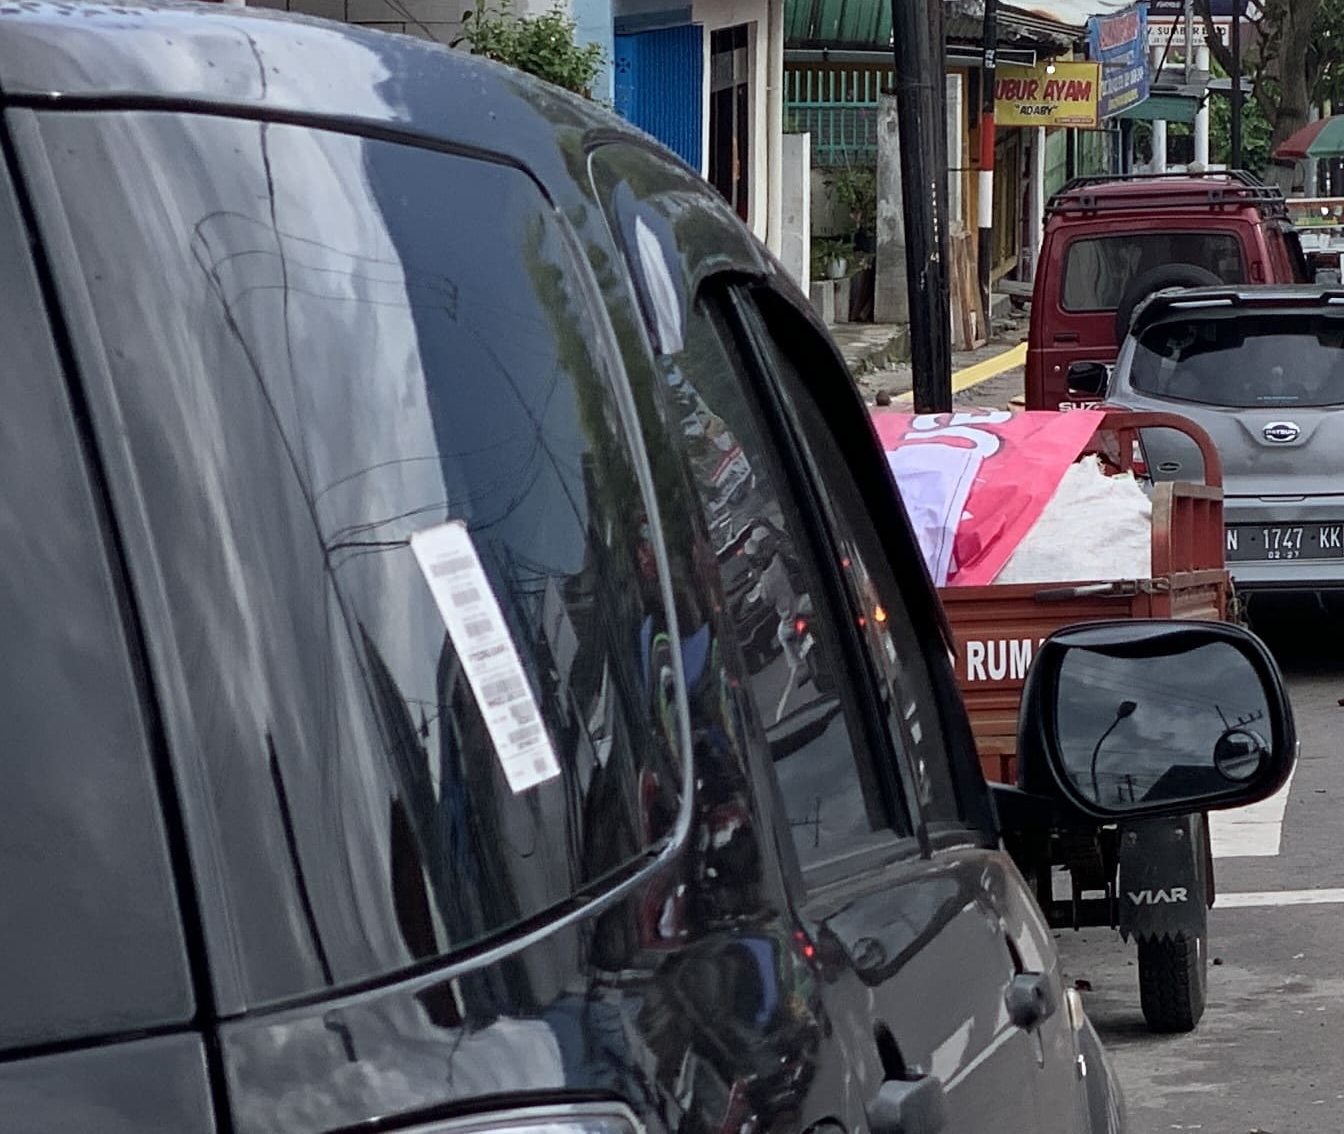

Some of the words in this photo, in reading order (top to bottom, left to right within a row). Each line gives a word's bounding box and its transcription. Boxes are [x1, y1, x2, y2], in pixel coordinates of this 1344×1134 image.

[1042, 79, 1092, 102] AYAM
[1226, 529, 1239, 551] N
[1262, 527, 1304, 550] 1747
[1319, 526, 1341, 549] KK
[966, 638, 1045, 682] RUM
[1127, 886, 1189, 906] VIAR
